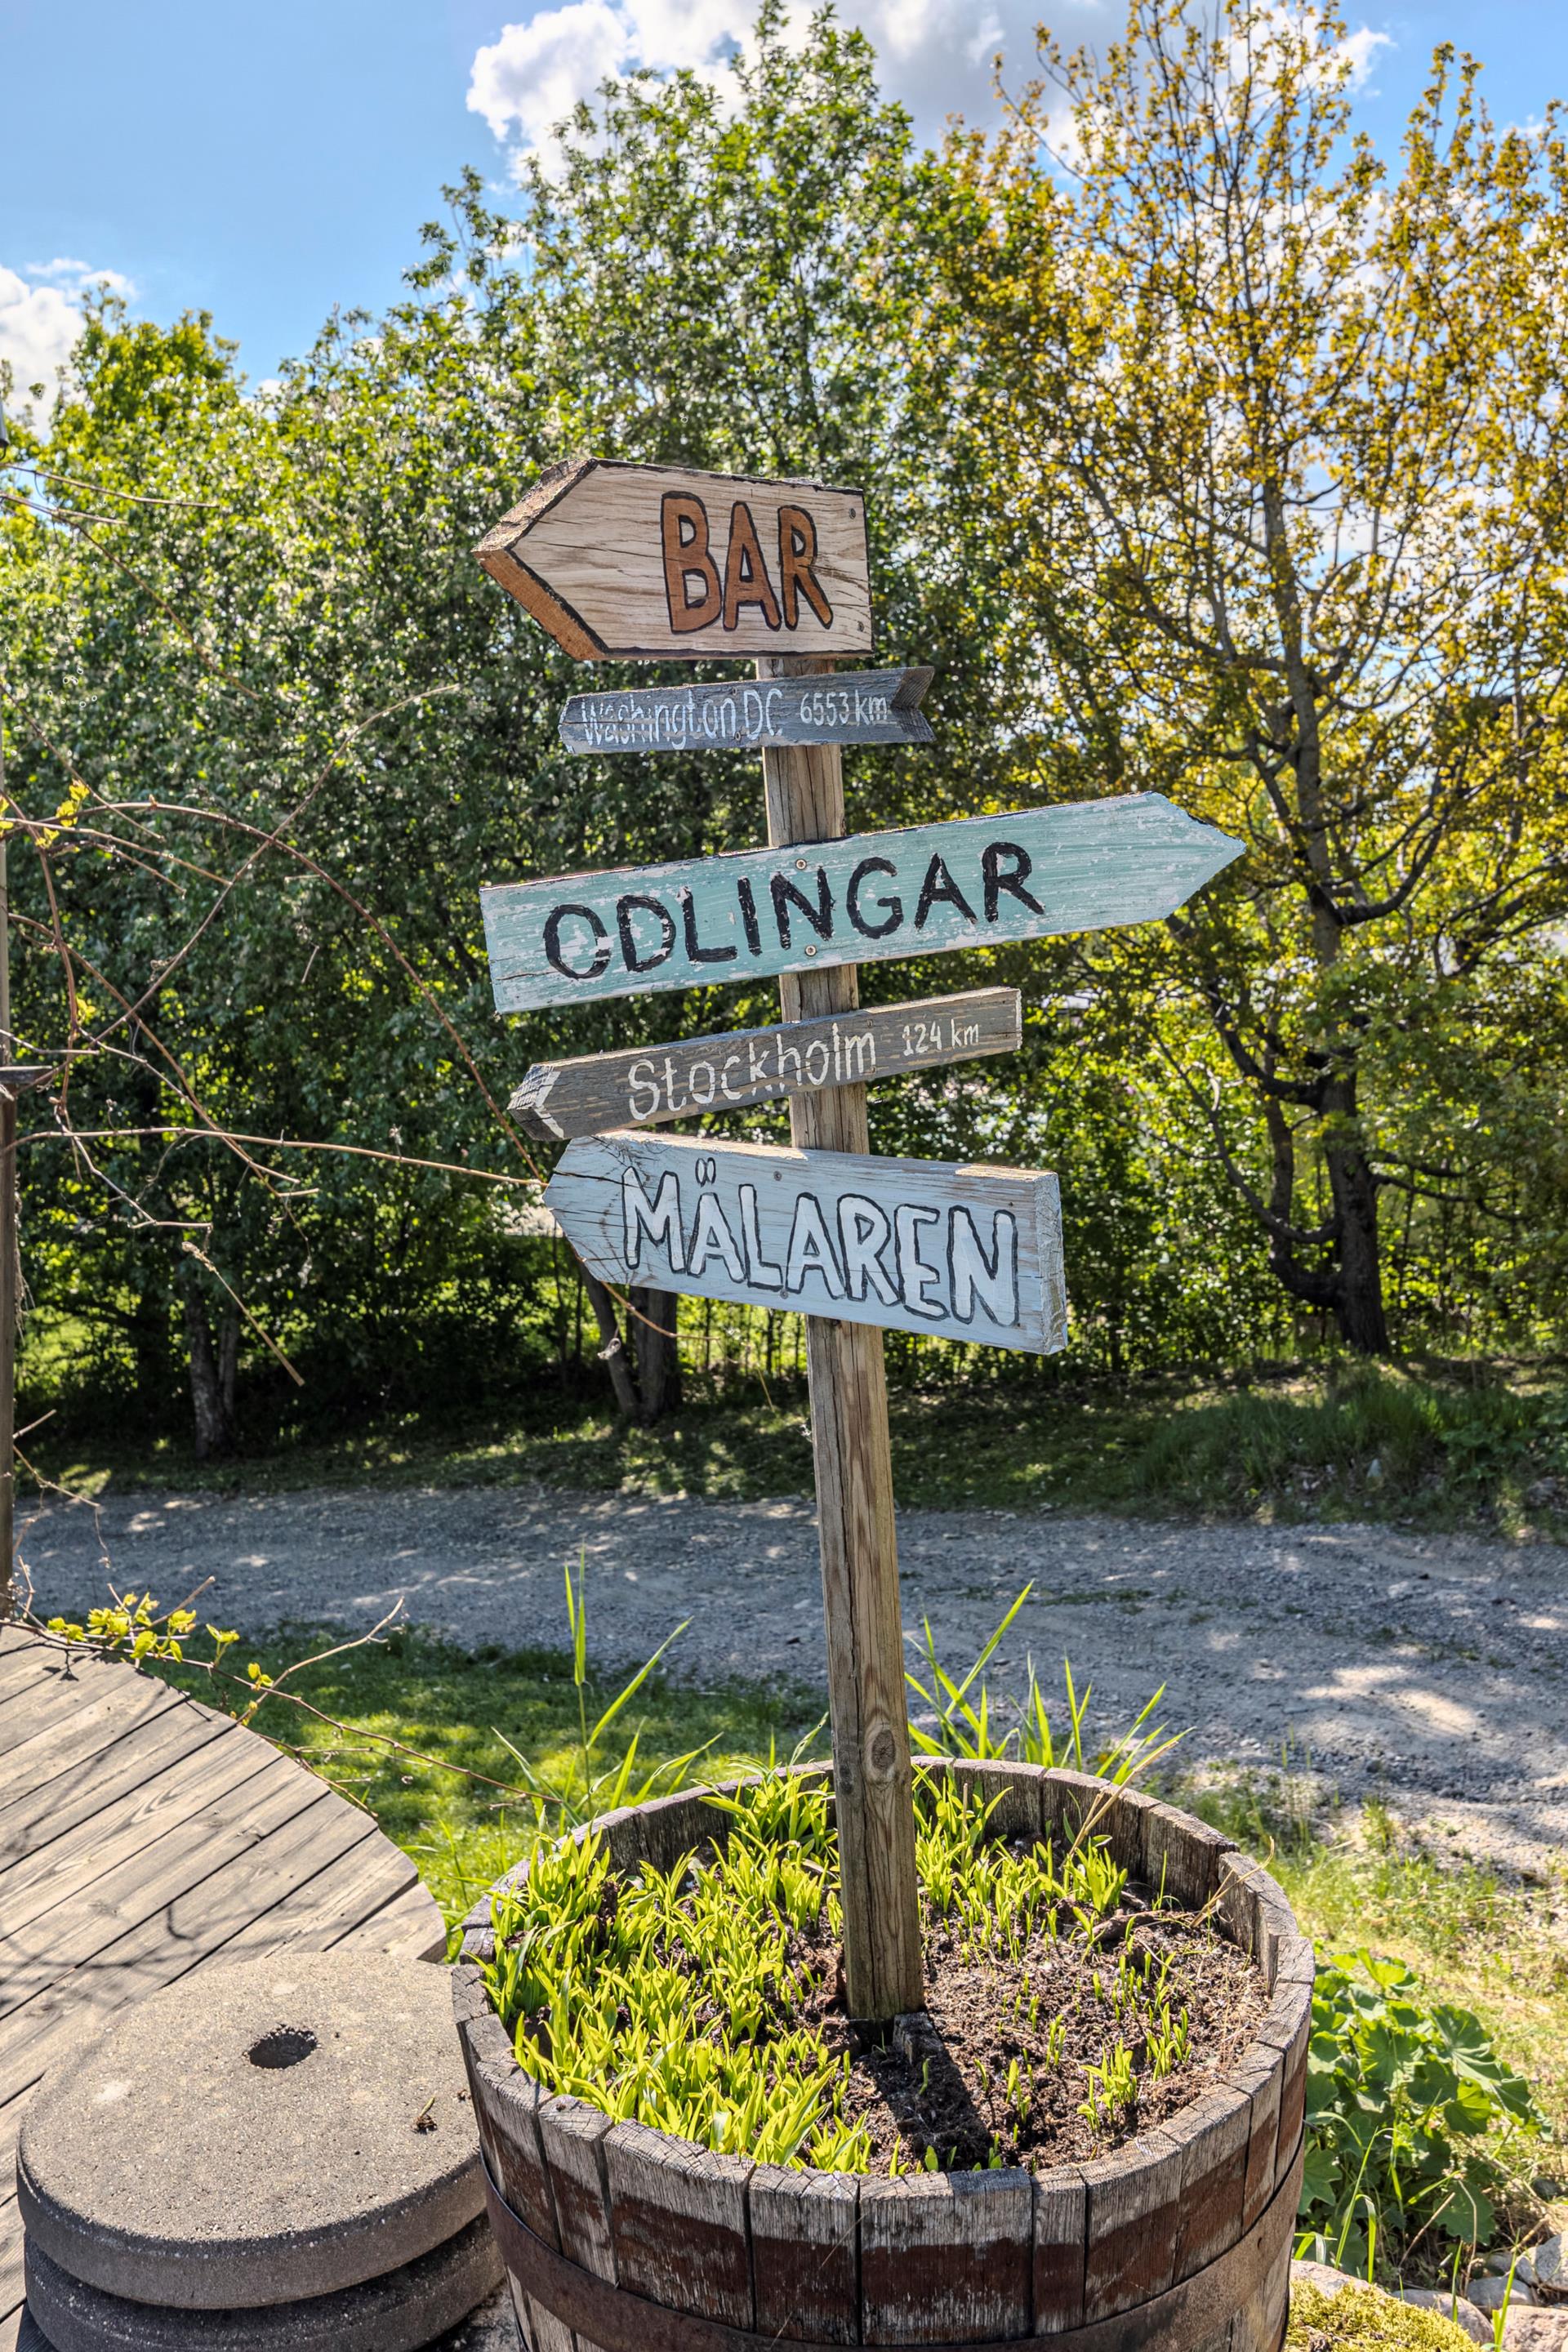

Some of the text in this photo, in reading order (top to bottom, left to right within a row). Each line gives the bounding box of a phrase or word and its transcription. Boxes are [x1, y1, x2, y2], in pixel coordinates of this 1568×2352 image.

[660, 491, 833, 635] BAR
[581, 688, 888, 751] Washington DC 6553 km
[542, 841, 1045, 980] ODLINGAR
[628, 1018, 980, 1121] Stockholm 124 km
[621, 1157, 1020, 1328] MÄLAREN
